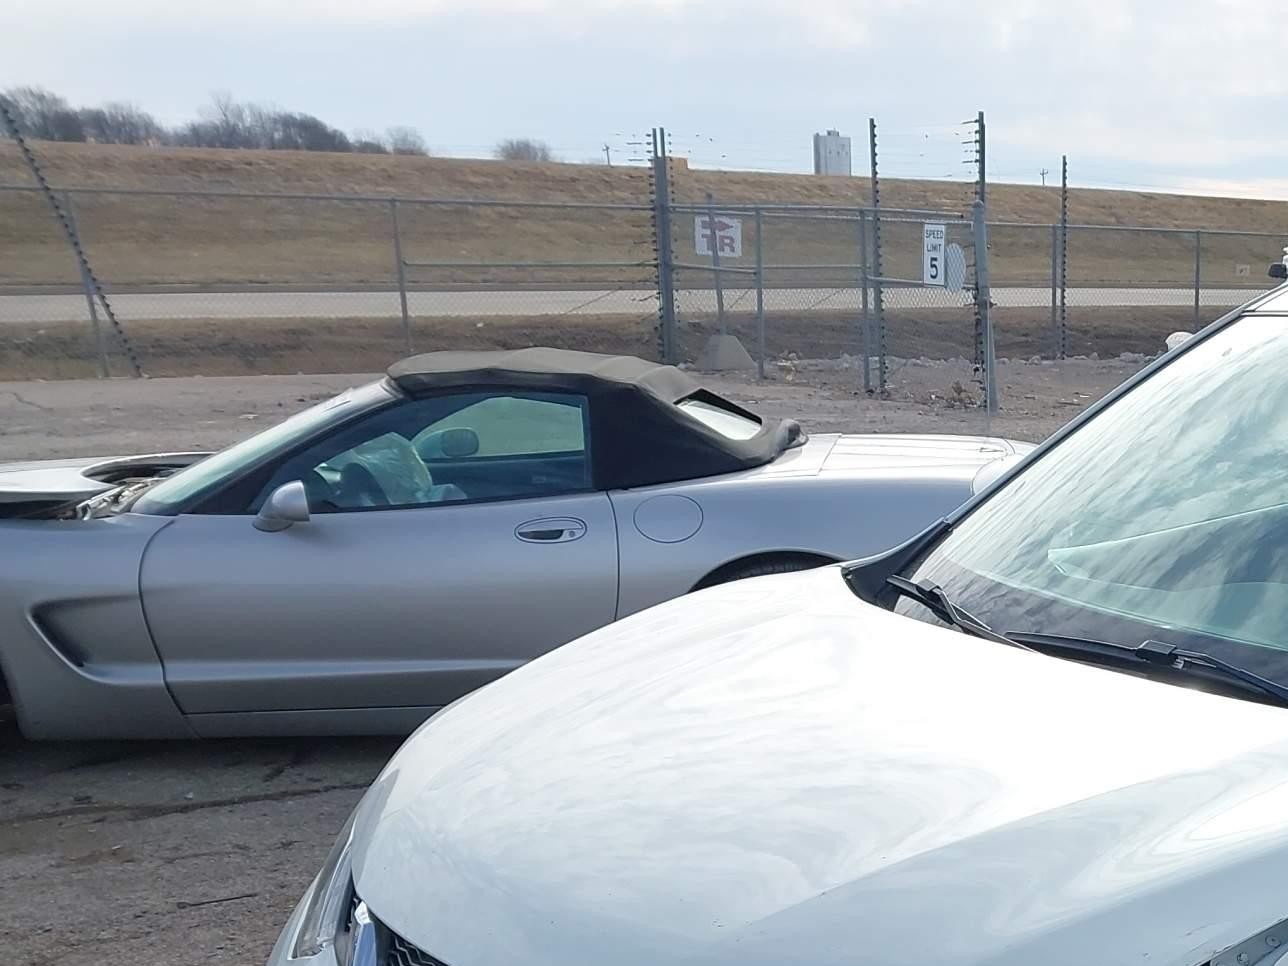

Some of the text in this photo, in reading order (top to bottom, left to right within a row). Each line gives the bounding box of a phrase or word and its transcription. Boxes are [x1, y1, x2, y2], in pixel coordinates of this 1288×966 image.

[925, 229, 943, 239] SPEED
[927, 243, 941, 252] LIMIT
[930, 257, 938, 279] 5
